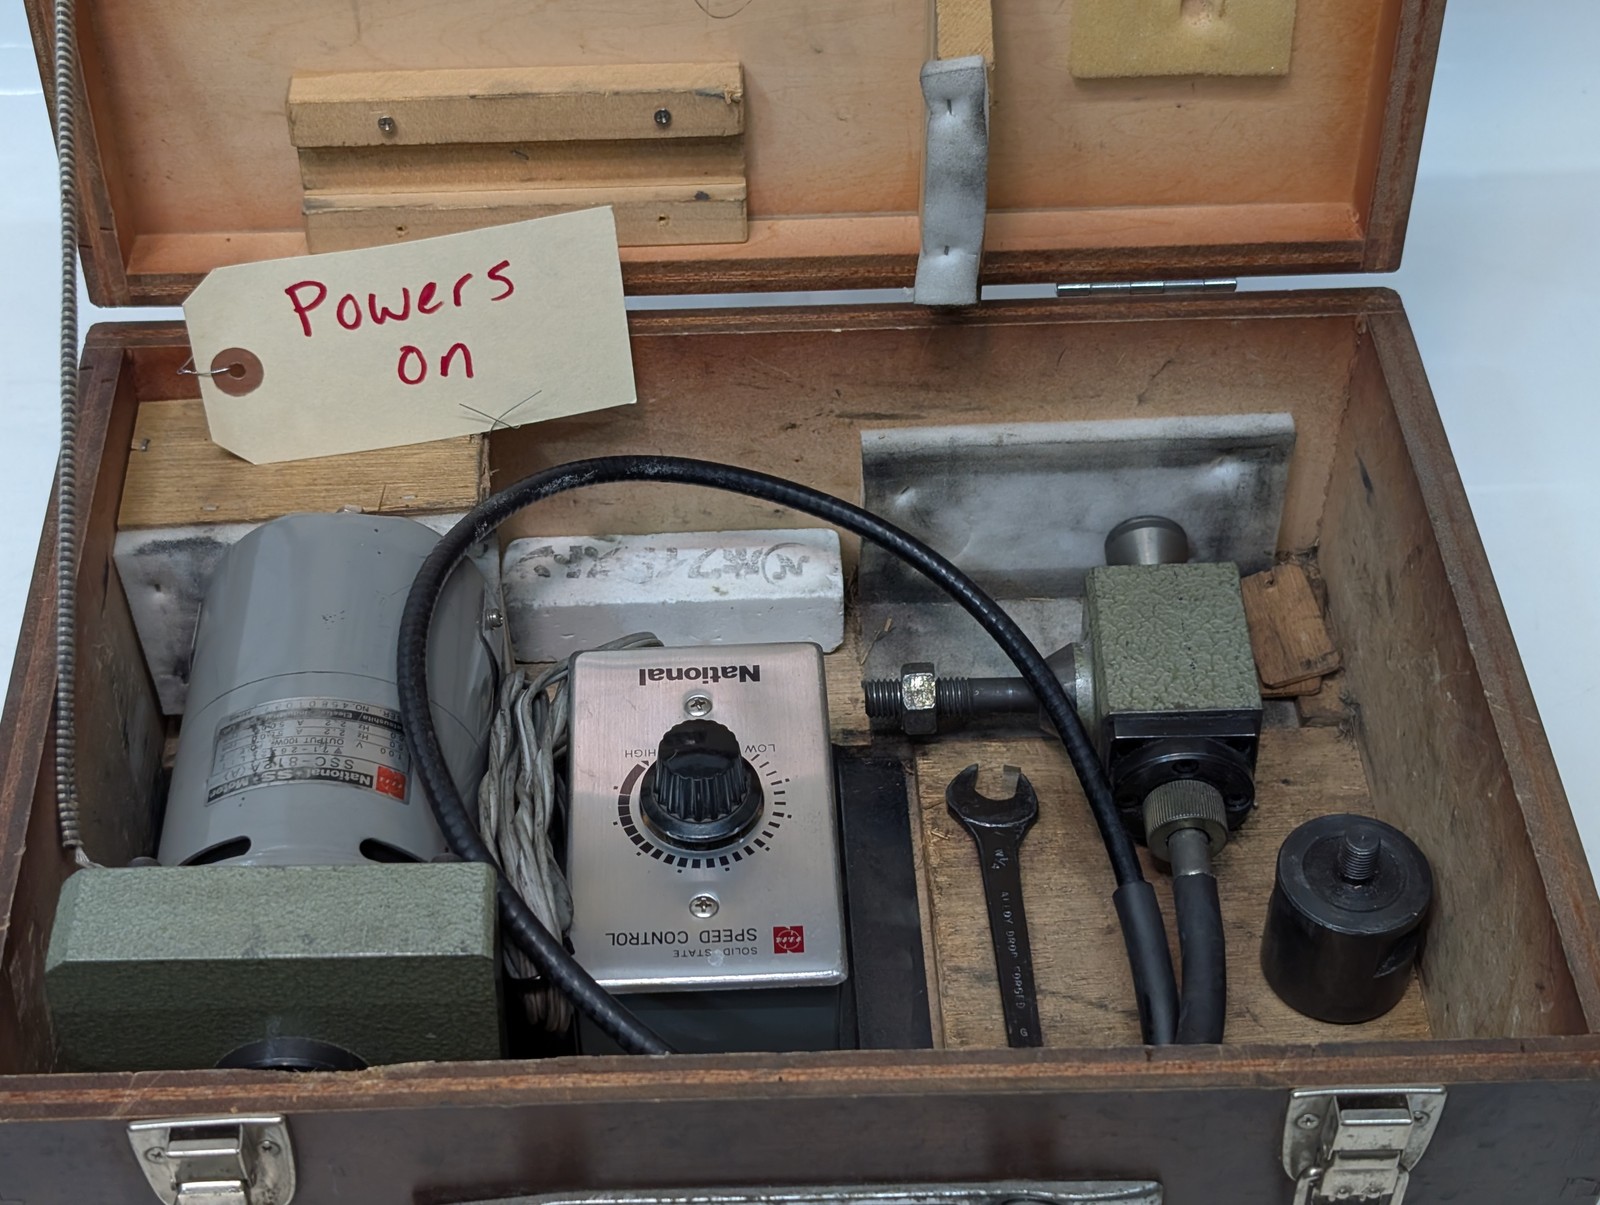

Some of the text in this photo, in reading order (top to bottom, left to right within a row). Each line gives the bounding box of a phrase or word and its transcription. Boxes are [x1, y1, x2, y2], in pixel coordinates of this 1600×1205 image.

[284, 259, 514, 338] Powers
[638, 664, 761, 686] National
[304, 737, 344, 745] OUTPUT
[745, 743, 775, 753] LOW
[625, 748, 656, 758] HIGH
[261, 769, 293, 782] SS
[306, 768, 371, 786] National
[209, 778, 249, 798] Motor
[605, 930, 689, 946] CONTROL
[699, 927, 758, 943] SPEED
[673, 946, 758, 958] SOLID STATE
